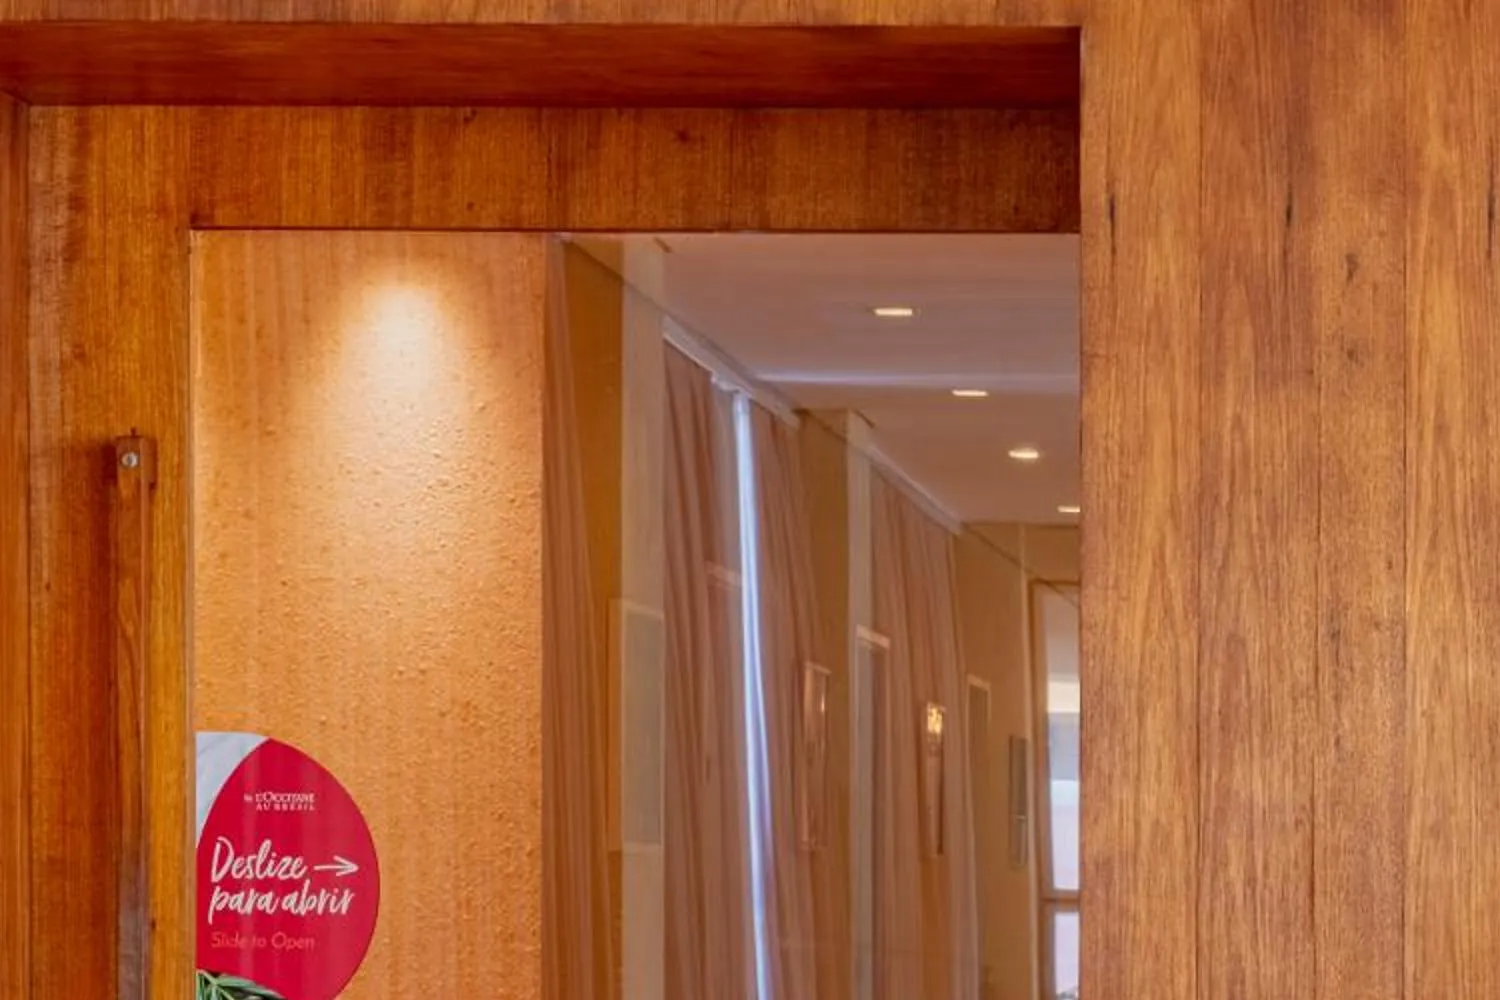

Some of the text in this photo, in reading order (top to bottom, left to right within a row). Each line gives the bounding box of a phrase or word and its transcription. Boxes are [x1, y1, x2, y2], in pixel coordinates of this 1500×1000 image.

[210, 836, 308, 883] Deslize
[207, 878, 355, 925] para abrir
[211, 931, 248, 948] Slide
[271, 931, 315, 950] Open
